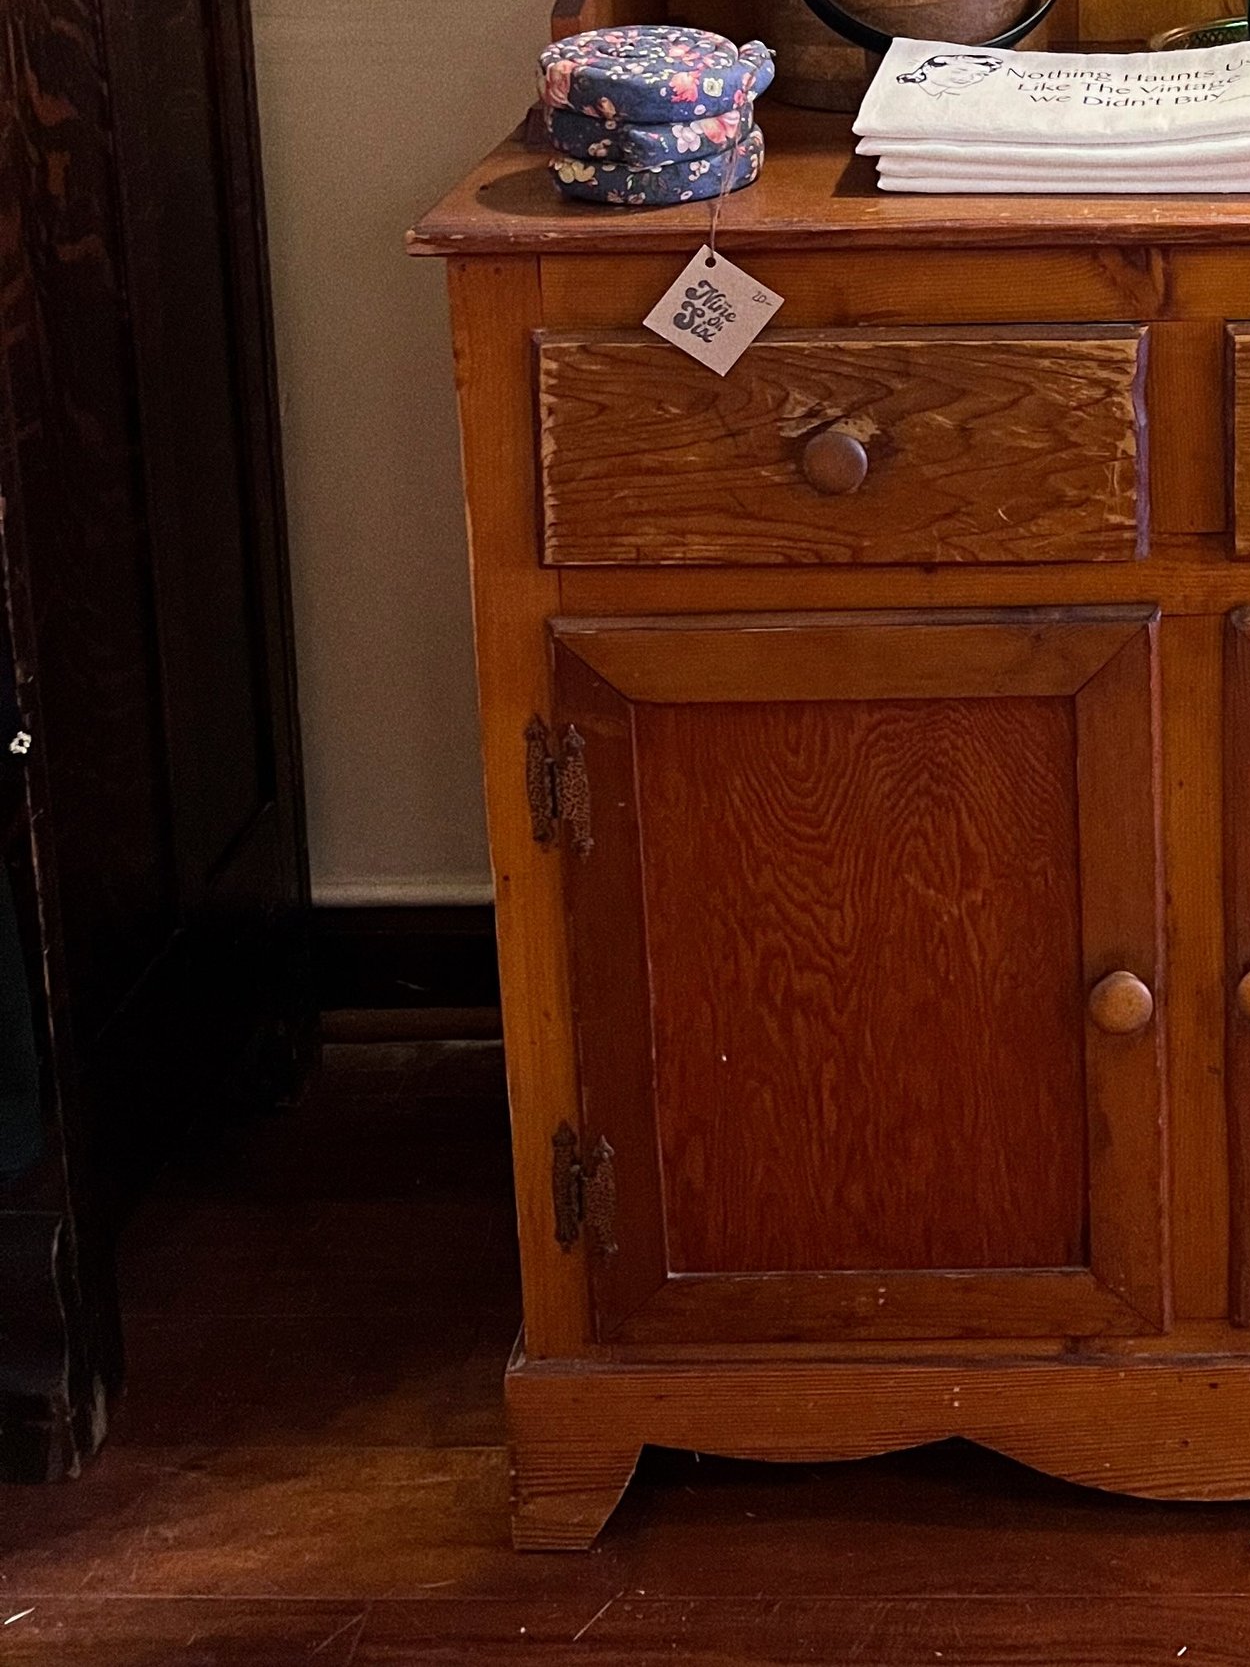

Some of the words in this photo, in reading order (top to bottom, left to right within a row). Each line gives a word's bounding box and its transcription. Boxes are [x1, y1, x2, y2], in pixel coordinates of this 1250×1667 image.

[1006, 67, 1112, 82] Nothing
[1124, 69, 1214, 82] Haunts
[1017, 82, 1071, 91] Like
[1080, 82, 1131, 94] The
[1140, 74, 1241, 94] Vintage
[1029, 94, 1071, 103] We
[1082, 95, 1161, 107] Didn't
[1174, 90, 1226, 104] Buy
[684, 279, 737, 323] Nine
[672, 300, 717, 344] Six
